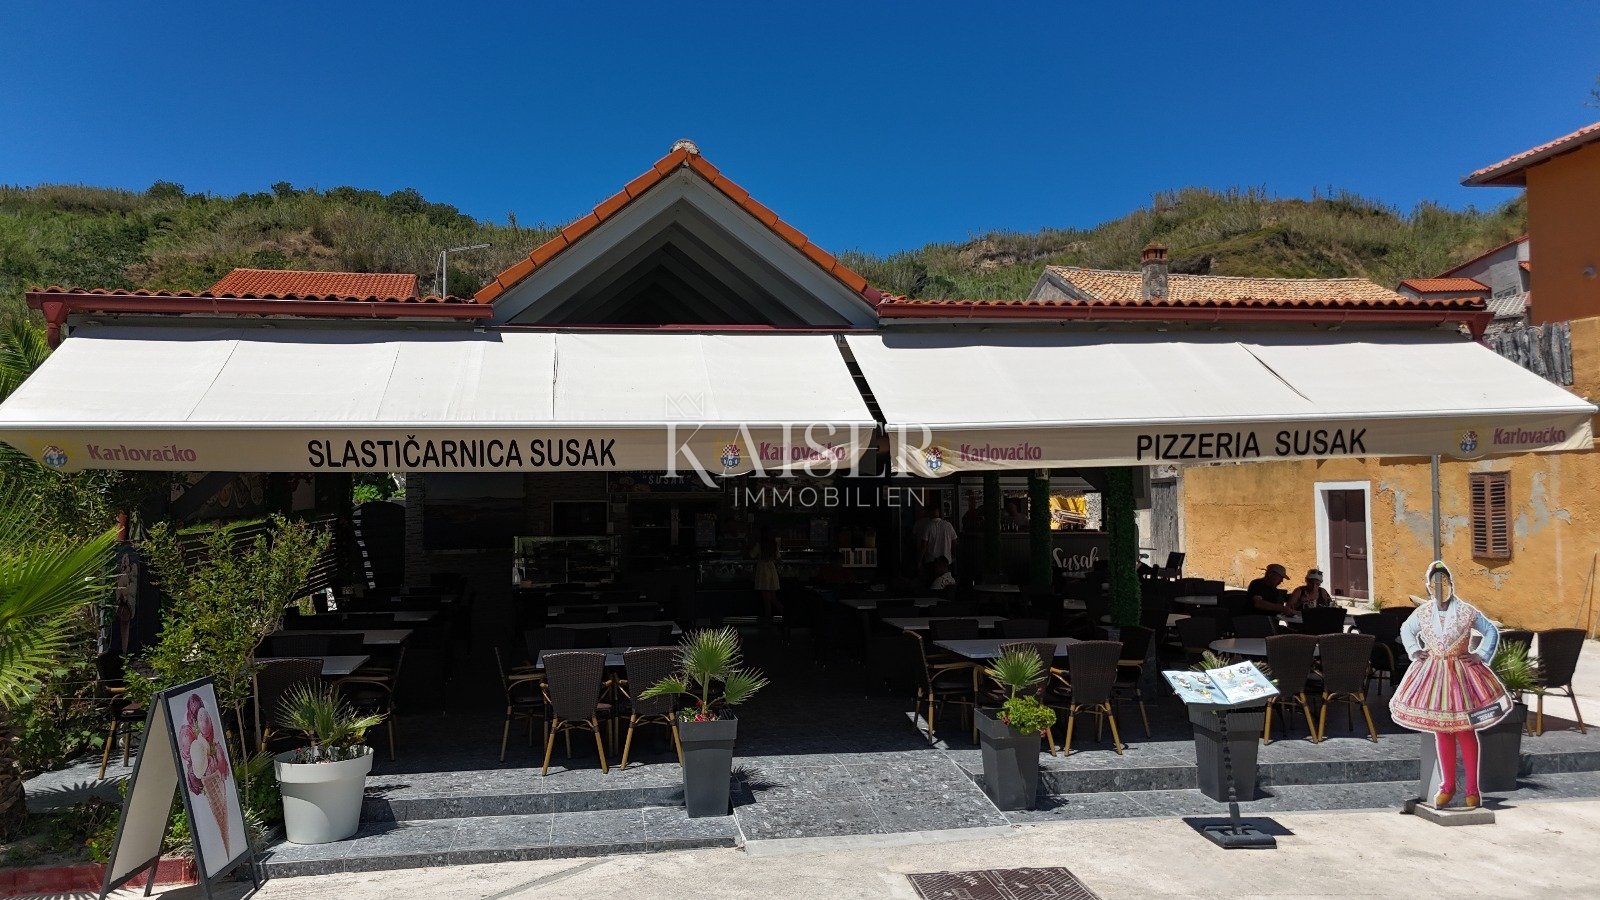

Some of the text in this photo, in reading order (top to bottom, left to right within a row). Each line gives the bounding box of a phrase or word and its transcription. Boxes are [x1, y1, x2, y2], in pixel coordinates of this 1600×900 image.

[1136, 428, 1367, 461] PIZZERIA SUSAK
[1493, 427, 1566, 445] Karlovačko
[86, 443, 197, 462] Karlovačko
[308, 434, 616, 468] SLASTIČARNICA SUSAK
[759, 441, 846, 461] Karlovačko
[960, 442, 1042, 462] Karlovačko
[1052, 546, 1099, 571] Susak
